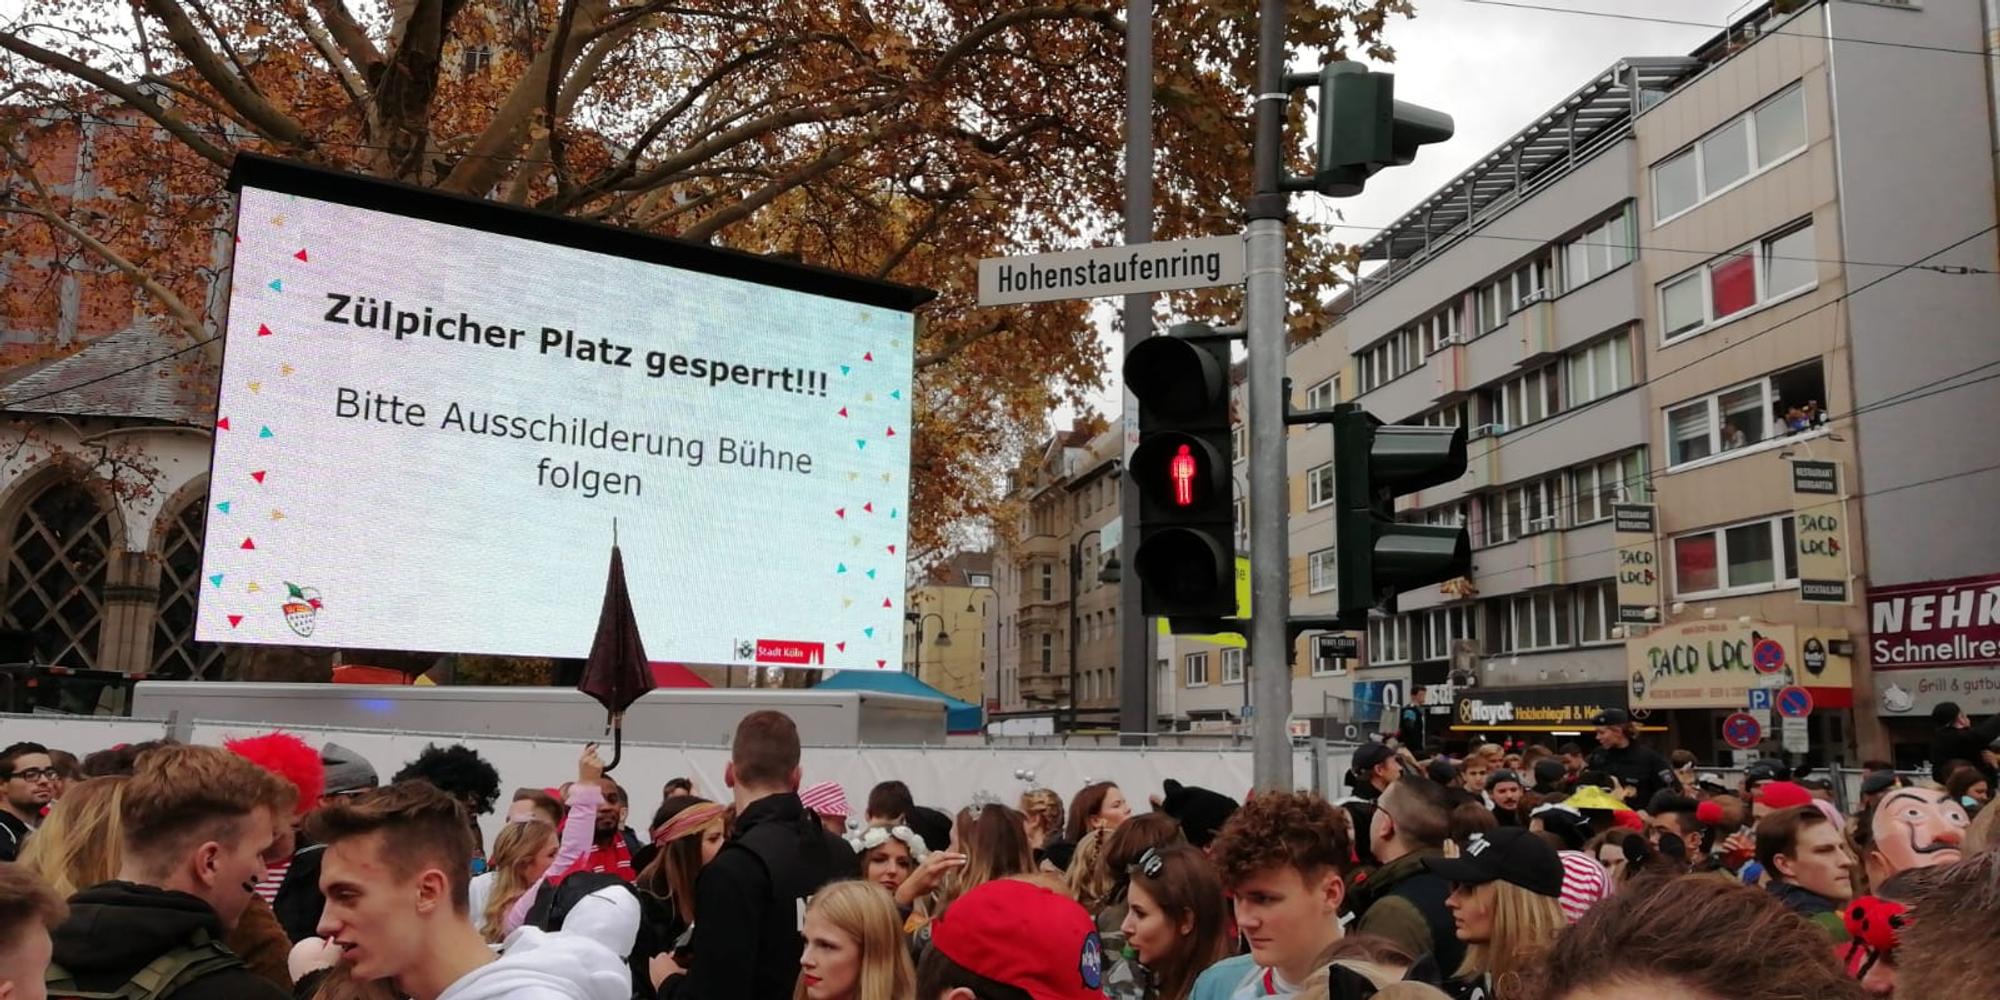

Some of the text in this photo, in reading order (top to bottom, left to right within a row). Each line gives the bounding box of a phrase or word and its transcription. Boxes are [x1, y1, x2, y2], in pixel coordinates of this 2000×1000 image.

[998, 248, 1221, 293] Hohenstaufenring
[324, 292, 828, 397] Zülpicher Platz gesperrt!!!
[336, 387, 813, 474] Bitte Ausschilderung Bühne
[537, 457, 642, 499] folgen
[758, 646, 804, 658] Stadt Köln
[1706, 638, 1760, 674] LOC
[1874, 633, 2000, 663] Schnellre
[1752, 690, 1765, 708] P
[1918, 678, 1948, 693] Grill
[1471, 699, 1514, 725] Hayat
